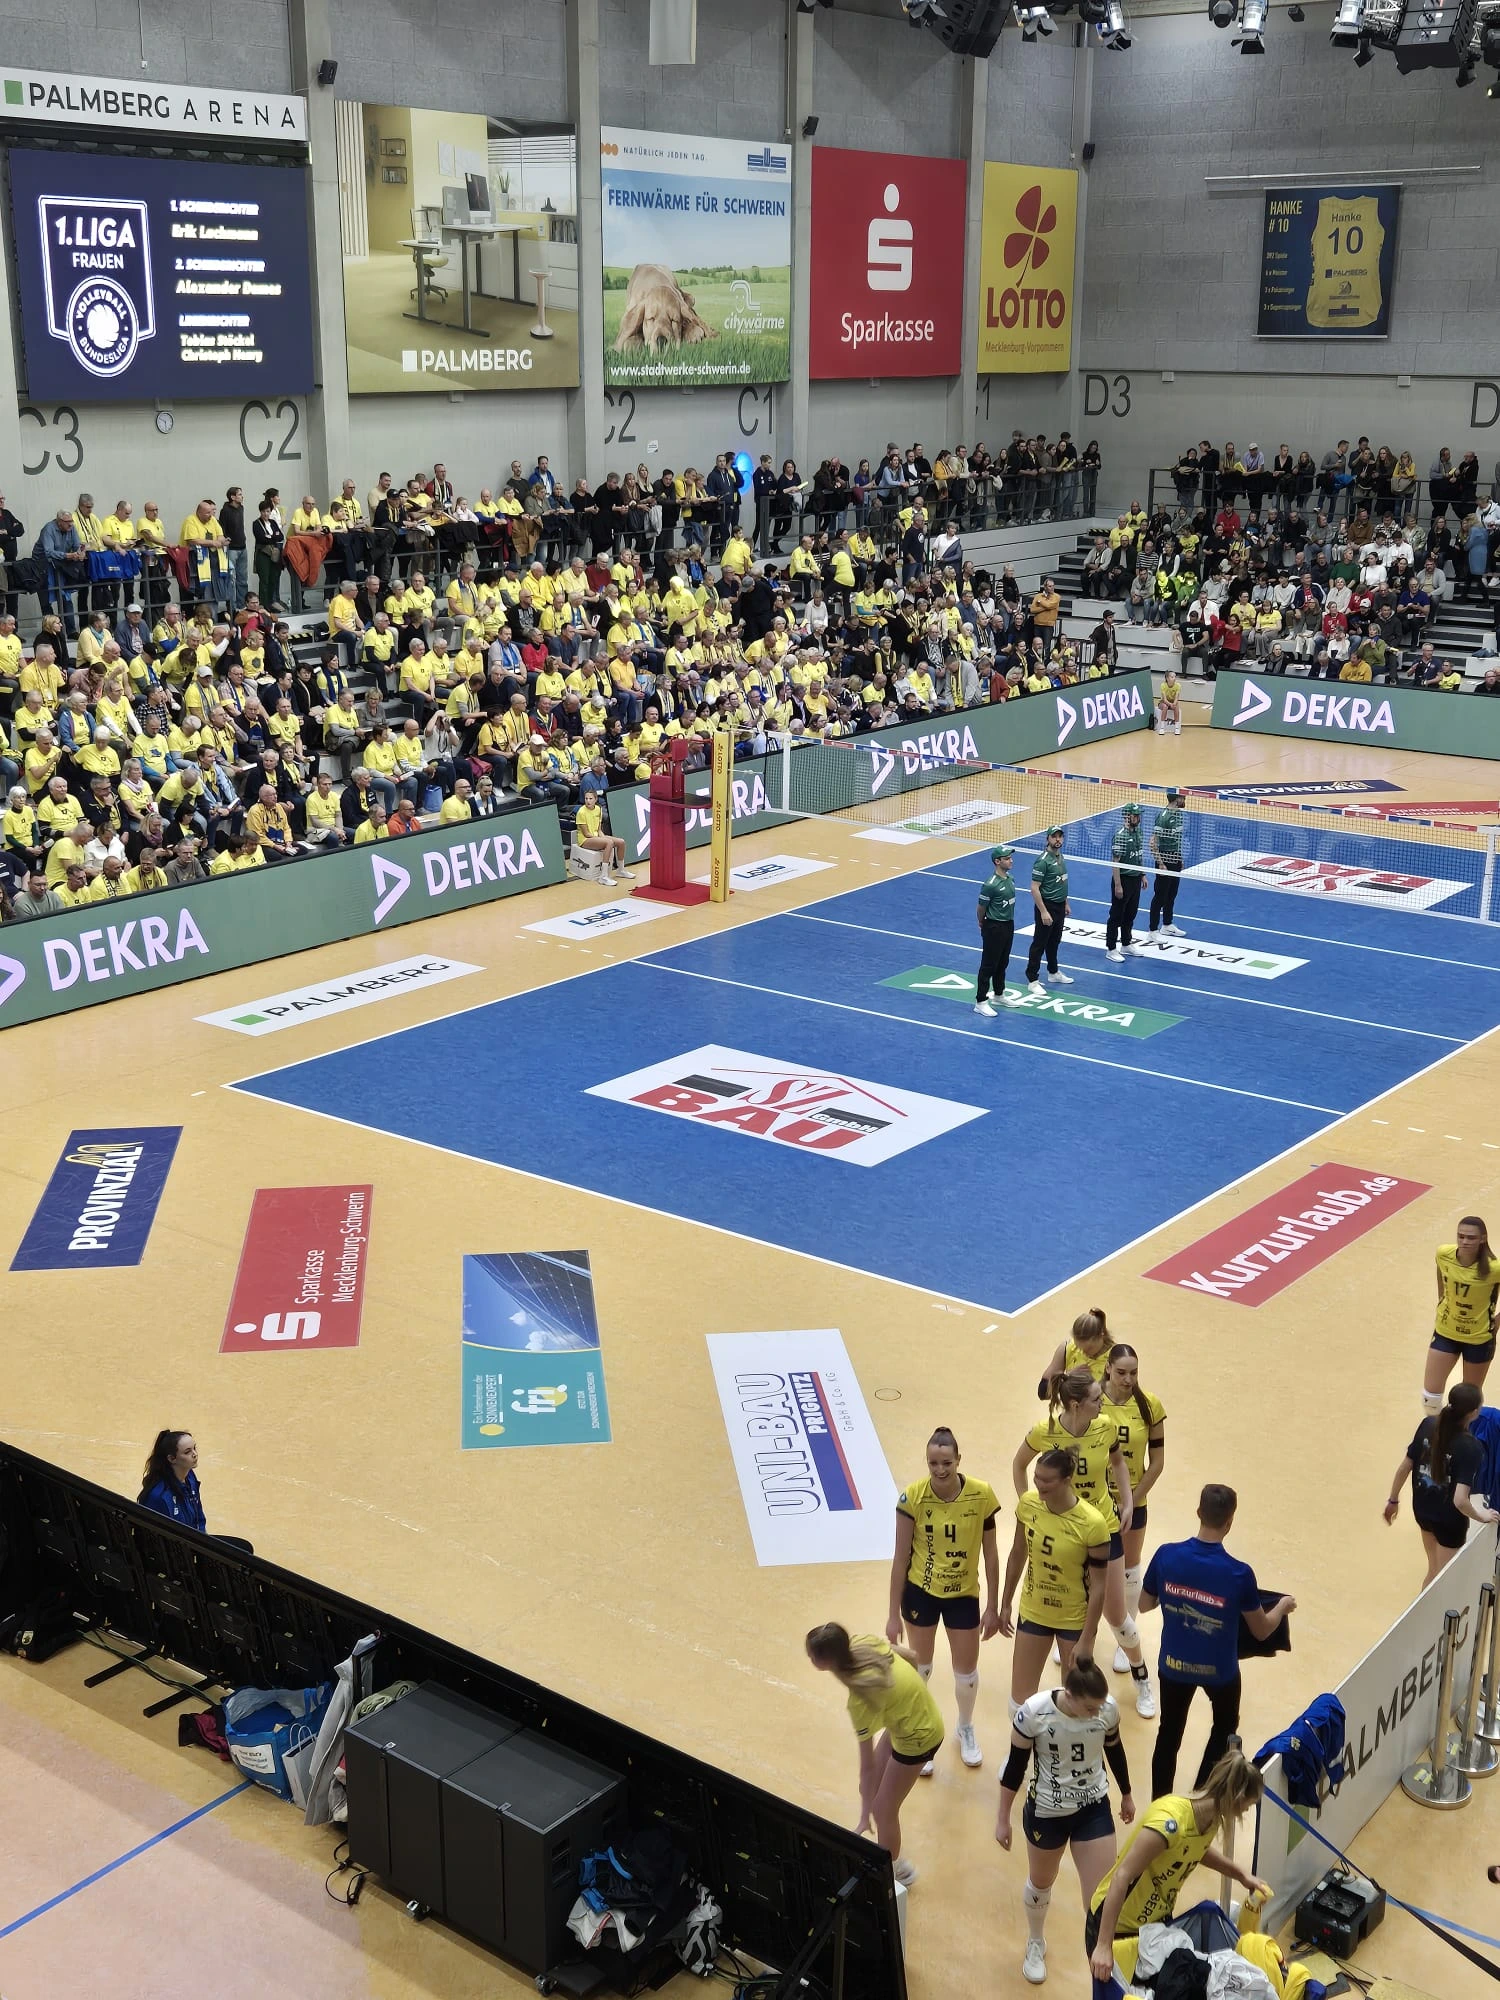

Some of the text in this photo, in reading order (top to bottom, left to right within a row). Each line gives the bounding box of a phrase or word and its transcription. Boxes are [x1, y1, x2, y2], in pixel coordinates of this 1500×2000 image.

[29, 82, 296, 129] PALMBERG ARENA
[623, 146, 664, 158] NATÜRLICH
[608, 188, 785, 217] FERNWÄRME FÜR SCHWERIN
[1270, 200, 1302, 216] HANKE
[1331, 212, 1362, 223] Hanke
[1278, 218, 1289, 232] 10
[1328, 226, 1364, 256] 10
[72, 252, 125, 269] FRAUEN
[75, 288, 128, 321] VOLLEYBALL
[724, 313, 785, 334] citywärme
[986, 287, 1066, 329] LOTTO
[79, 336, 130, 364] BUNDESLIGA
[841, 312, 935, 350] Sparkasse
[985, 340, 1065, 355] Mecklenburg-Vorpommern
[422, 349, 533, 372] PALMBERG
[610, 360, 751, 377] www.stadtwerke-schwerin.de
[738, 386, 773, 437] C1
[1084, 373, 1131, 418] D3
[18, 406, 84, 475] C3
[240, 400, 302, 463] C2
[1082, 685, 1145, 729] DEKRA
[1282, 691, 1396, 734] DEKRA
[901, 725, 979, 776] DEKRA
[423, 828, 545, 898] DEKRA
[43, 907, 210, 992] DEKRA
[265, 960, 452, 1018] PALMBERG
[628, 1084, 866, 1150] BAU
[812, 1113, 878, 1135] GmbH
[68, 1146, 144, 1250] PROVINZIAL
[331, 1192, 366, 1303] Mecklenburg-Schwerin
[1178, 1175, 1398, 1297] Kurzurlaub.de
[294, 1249, 326, 1304] Sparkasse
[1454, 1281, 1472, 1298] 17
[790, 1373, 828, 1434] PRIGNITZ
[735, 1373, 821, 1516] UNI-BAU
[1118, 1426, 1129, 1444] 9
[1077, 1457, 1088, 1475] 8
[945, 1524, 956, 1543] 4
[1041, 1535, 1055, 1556] 5
